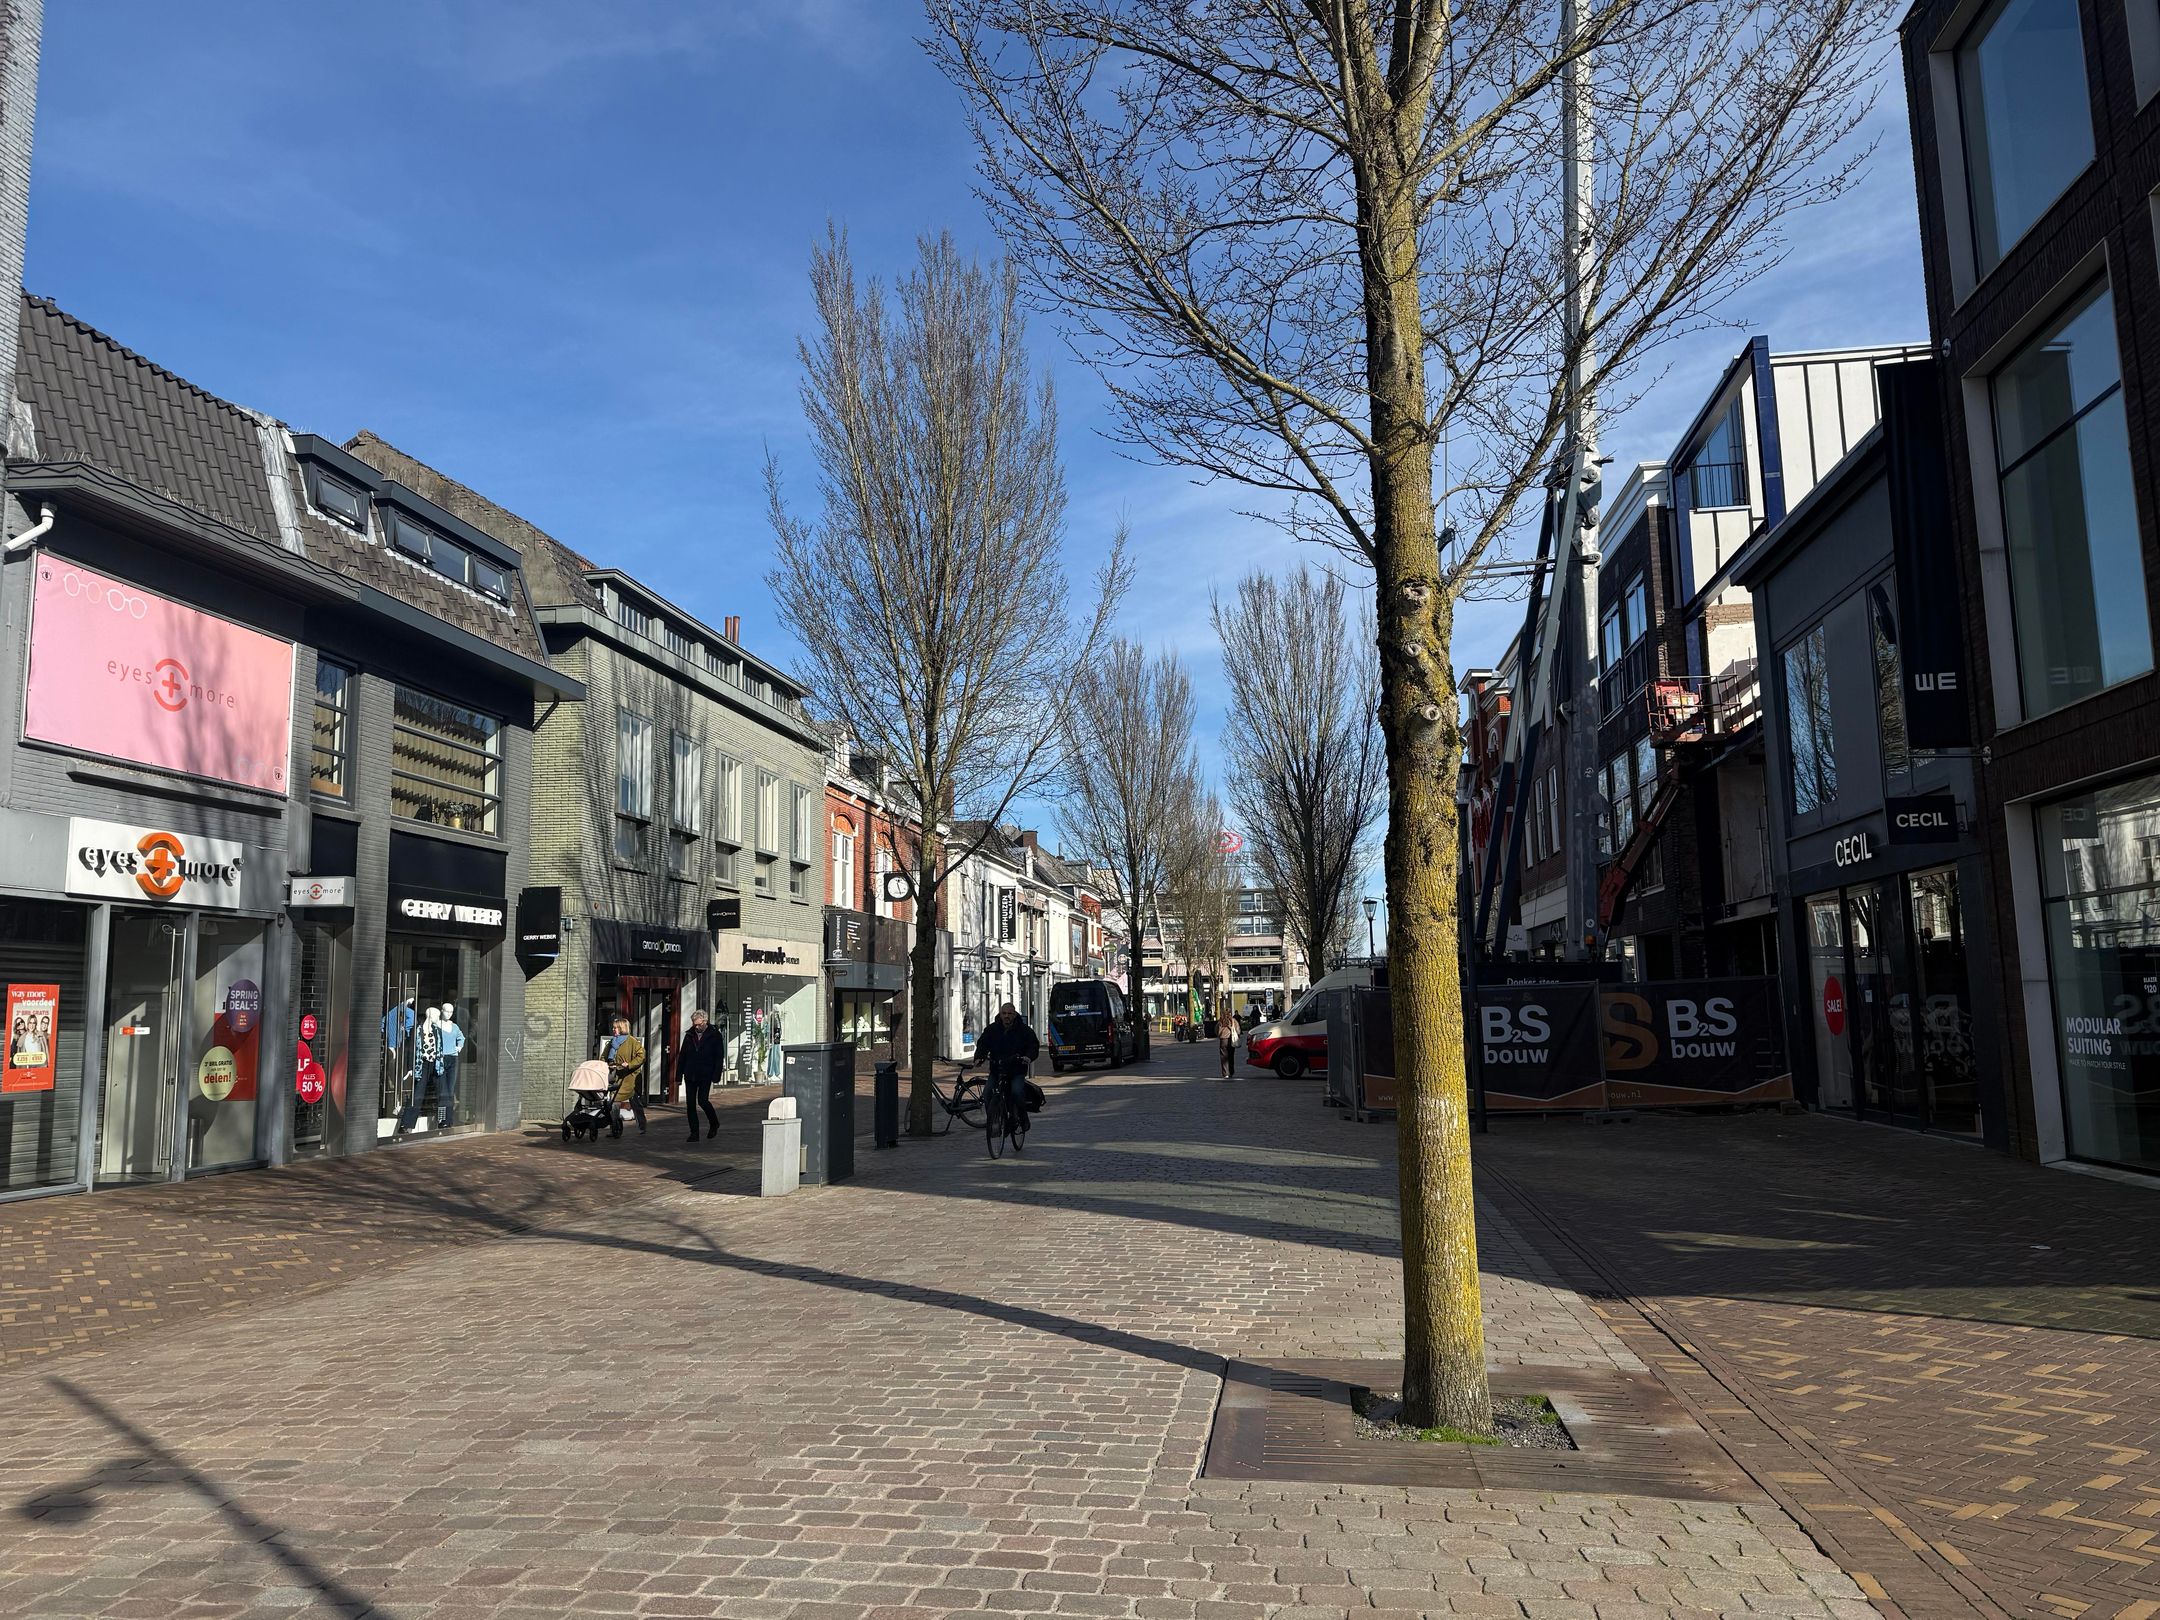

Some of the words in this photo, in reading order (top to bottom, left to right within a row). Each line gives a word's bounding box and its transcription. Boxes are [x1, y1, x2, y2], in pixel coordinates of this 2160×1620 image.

[107, 660, 152, 685] eyes
[189, 684, 235, 708] more
[1915, 672, 1958, 691] WE
[1896, 812, 1949, 828] CECIL
[1835, 832, 1872, 868] CECIL
[401, 899, 452, 920] GERRY
[454, 905, 503, 925] WEBER
[230, 990, 258, 1000] SPRING
[1826, 998, 1843, 1013] SALE!
[2066, 1017, 2121, 1035] MODULAR
[1484, 1045, 1549, 1064] bouw
[1671, 1039, 1736, 1059] bouw
[2068, 1037, 2112, 1055] SUITING
[203, 1072, 231, 1084] delen!
[302, 1081, 313, 1092] 50
[314, 1081, 323, 1092] %
